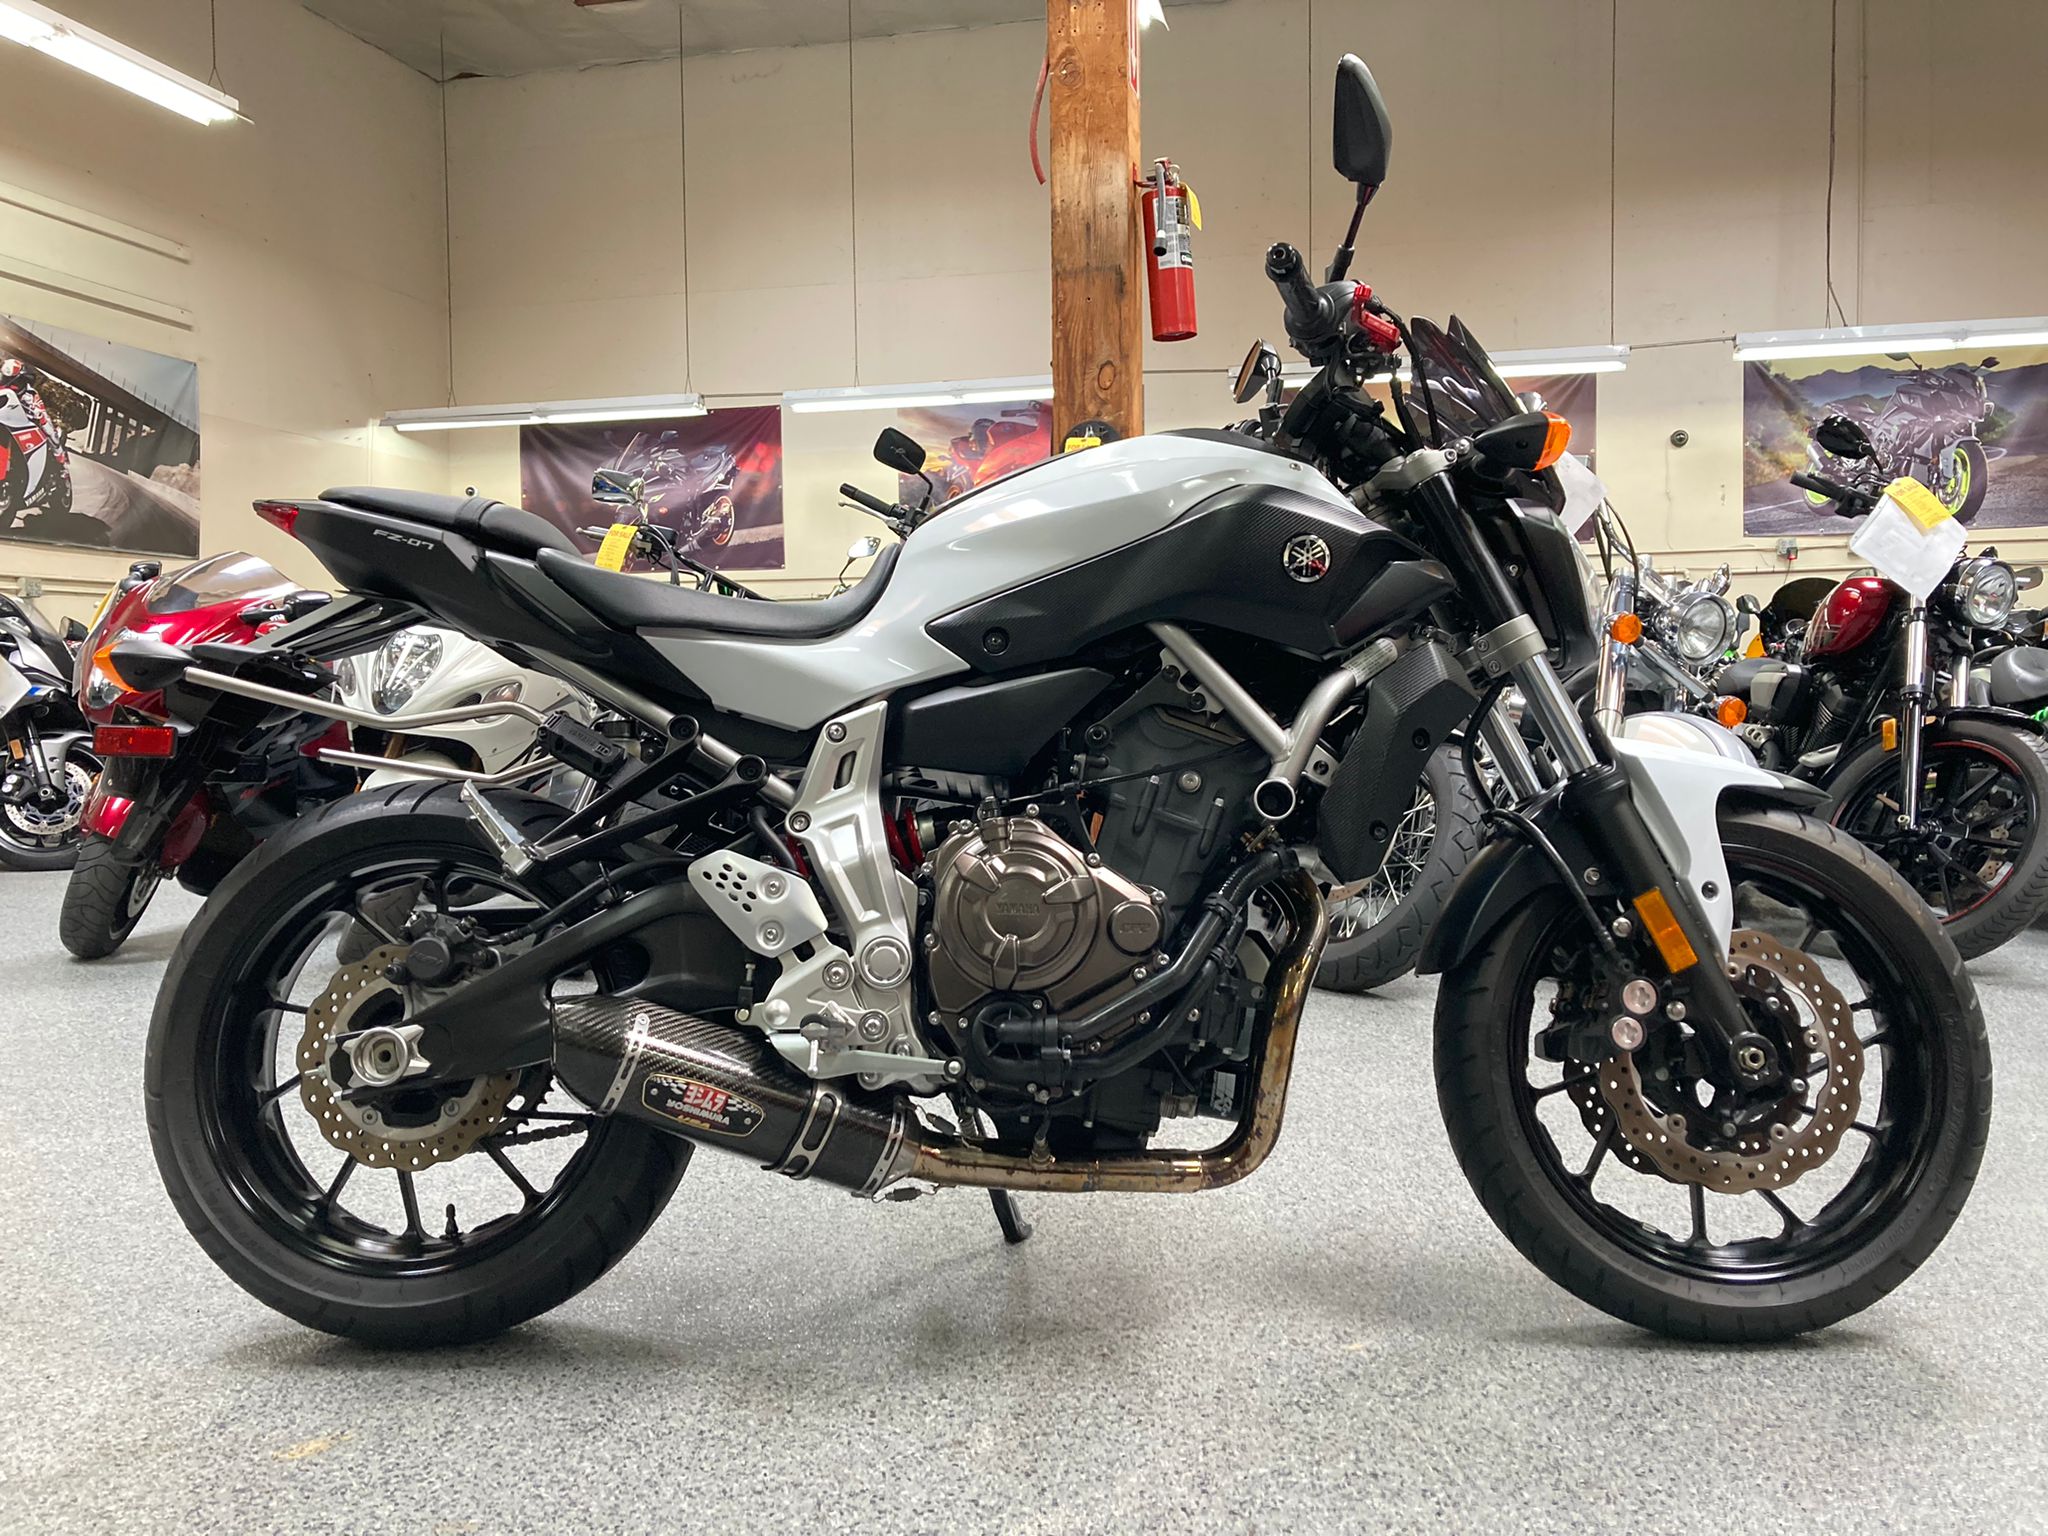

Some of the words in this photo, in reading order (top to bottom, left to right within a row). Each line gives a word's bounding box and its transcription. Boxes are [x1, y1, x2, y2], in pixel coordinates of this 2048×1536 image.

[373, 528, 435, 550] FZ-07
[996, 903, 1041, 916] YAMAHA
[666, 1098, 730, 1126] YOSHIMURA
